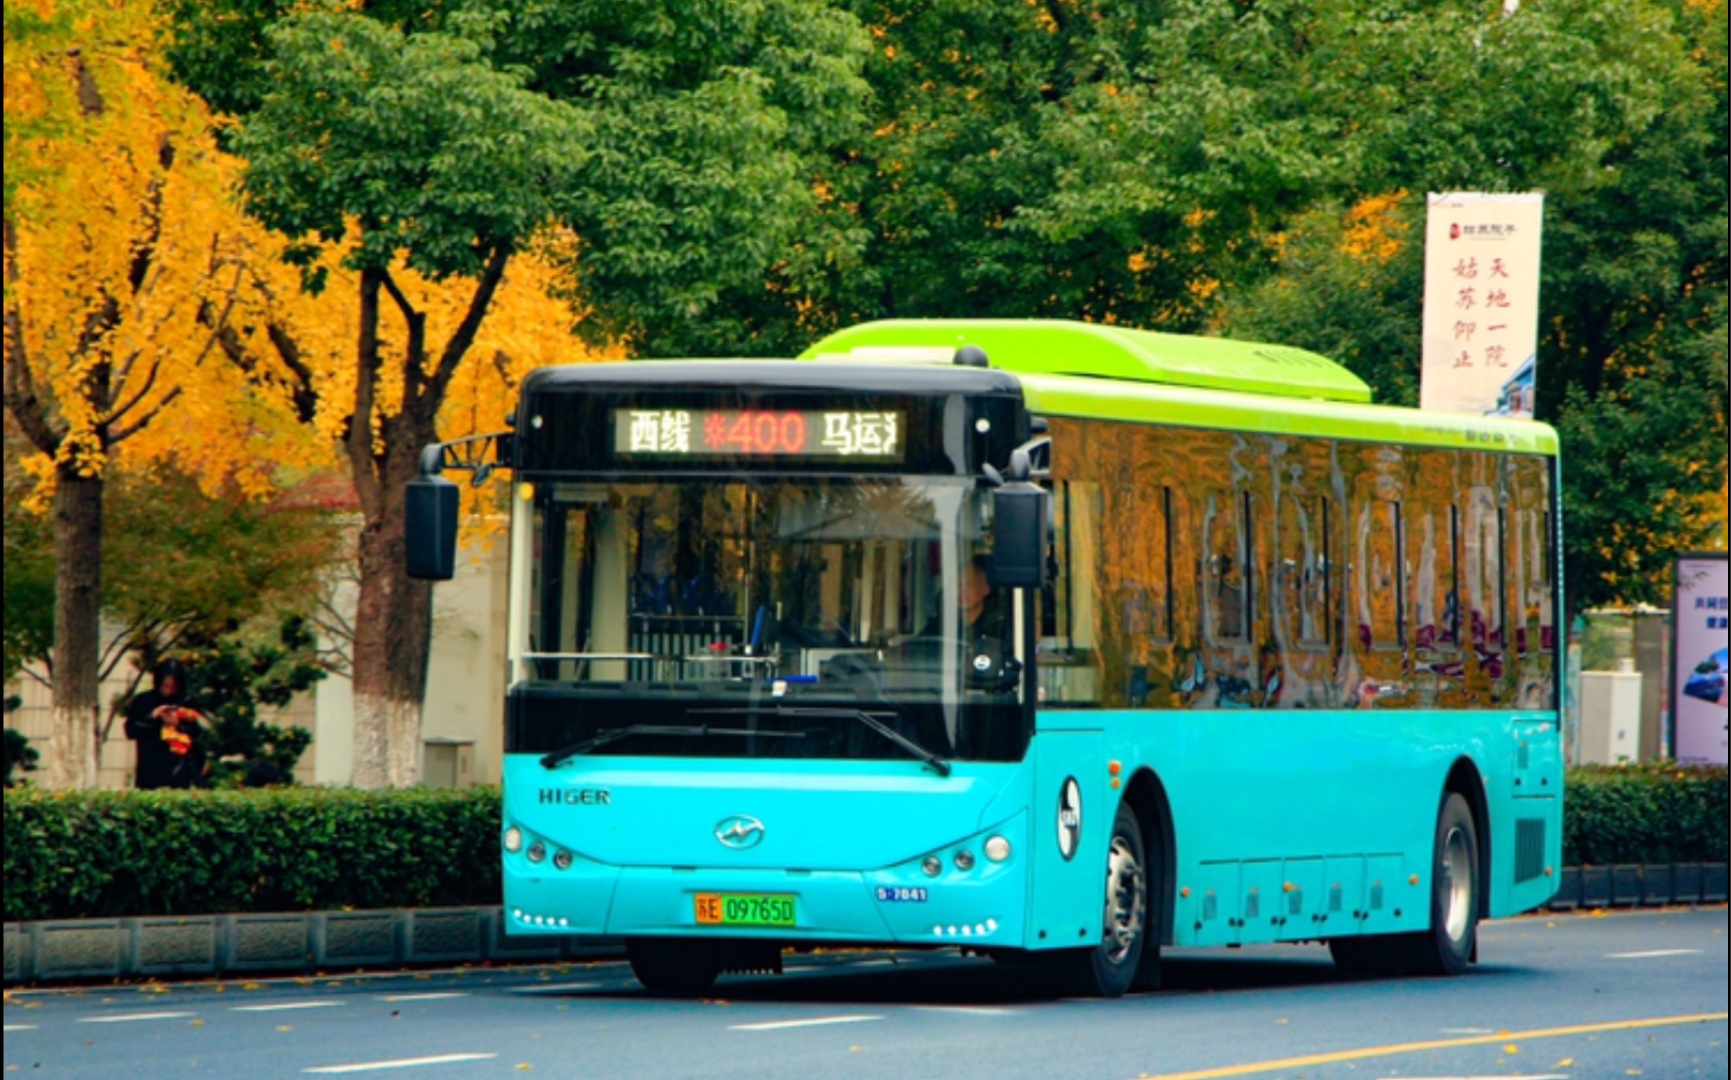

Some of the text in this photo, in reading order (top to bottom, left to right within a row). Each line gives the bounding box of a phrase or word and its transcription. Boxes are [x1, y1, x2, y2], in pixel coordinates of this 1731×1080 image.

[1452, 256, 1477, 369] 姑苏仰止
[1485, 257, 1510, 367] 天地一院
[629, 410, 690, 452] 西线
[539, 787, 611, 805] HIGER
